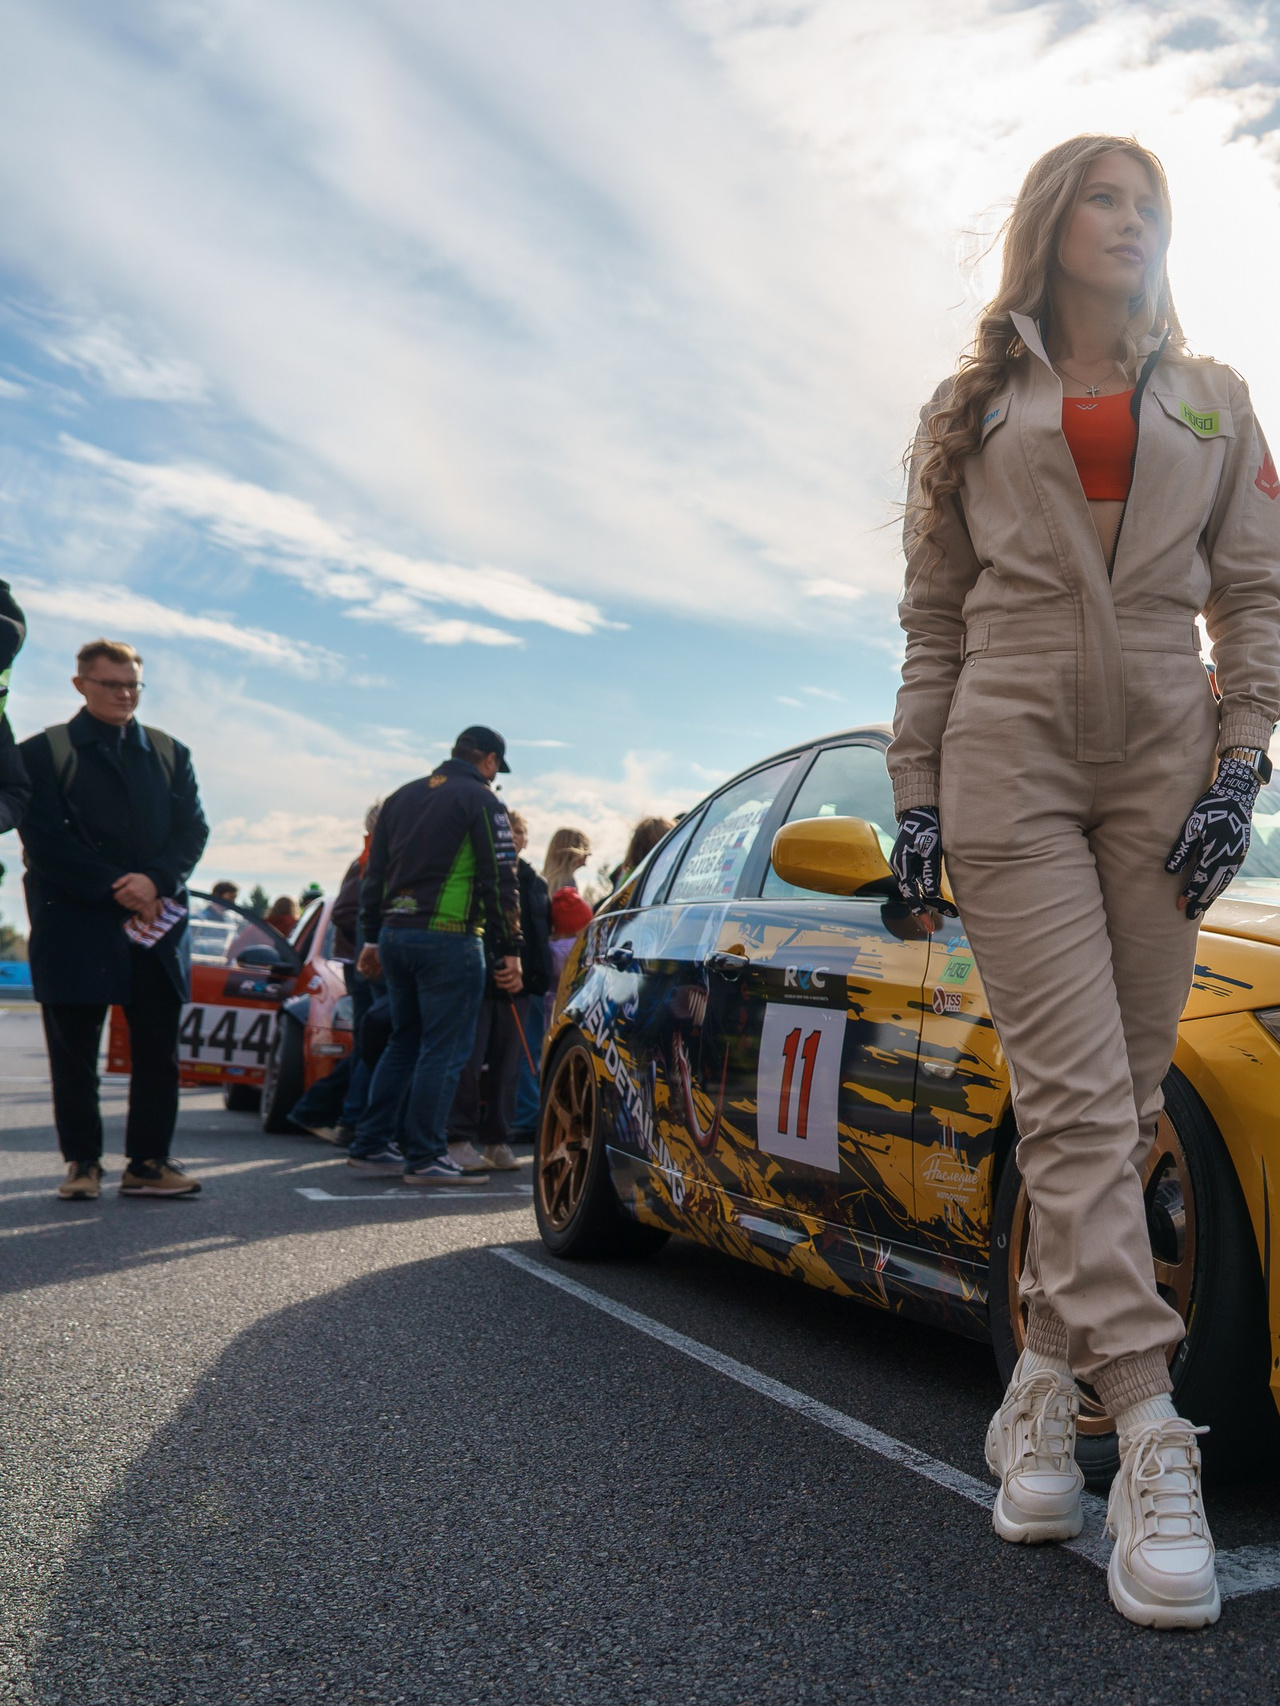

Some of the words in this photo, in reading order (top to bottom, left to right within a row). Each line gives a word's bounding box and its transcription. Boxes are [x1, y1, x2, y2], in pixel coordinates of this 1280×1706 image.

[1184, 406, 1213, 430] HOGO
[1223, 776, 1250, 792] HOGO
[944, 961, 971, 979] HOGO
[945, 994, 962, 1006] TSS
[179, 1006, 271, 1065] 444
[777, 1027, 822, 1140] 11
[605, 1039, 686, 1208] DETAILING
